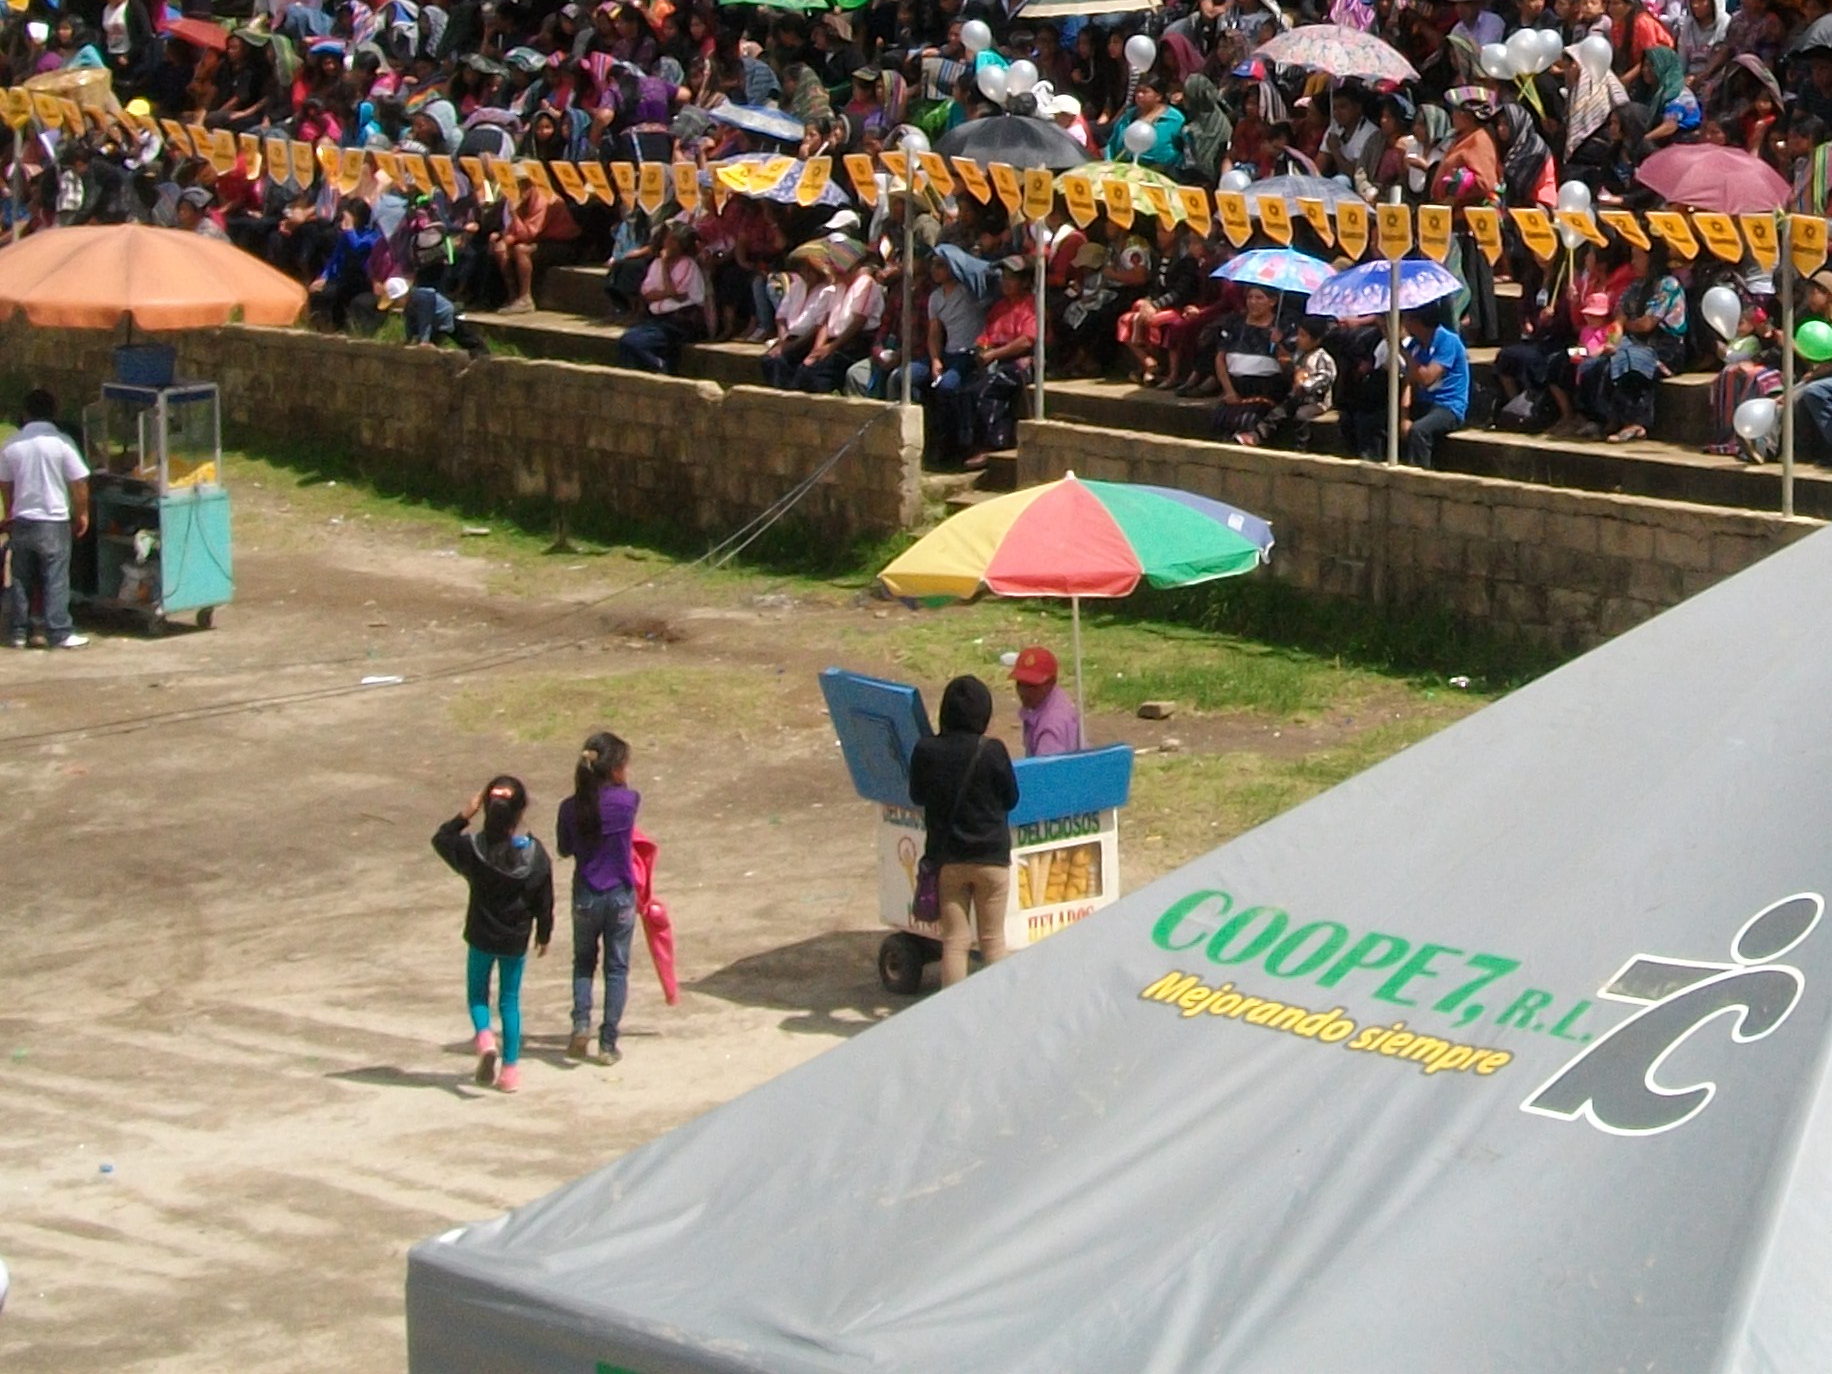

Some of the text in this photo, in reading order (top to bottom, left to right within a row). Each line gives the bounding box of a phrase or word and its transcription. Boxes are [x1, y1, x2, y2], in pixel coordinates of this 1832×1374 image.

[1017, 810, 1100, 846] DELICIOSOS
[1139, 968, 1514, 1077] Mejorando siempre
